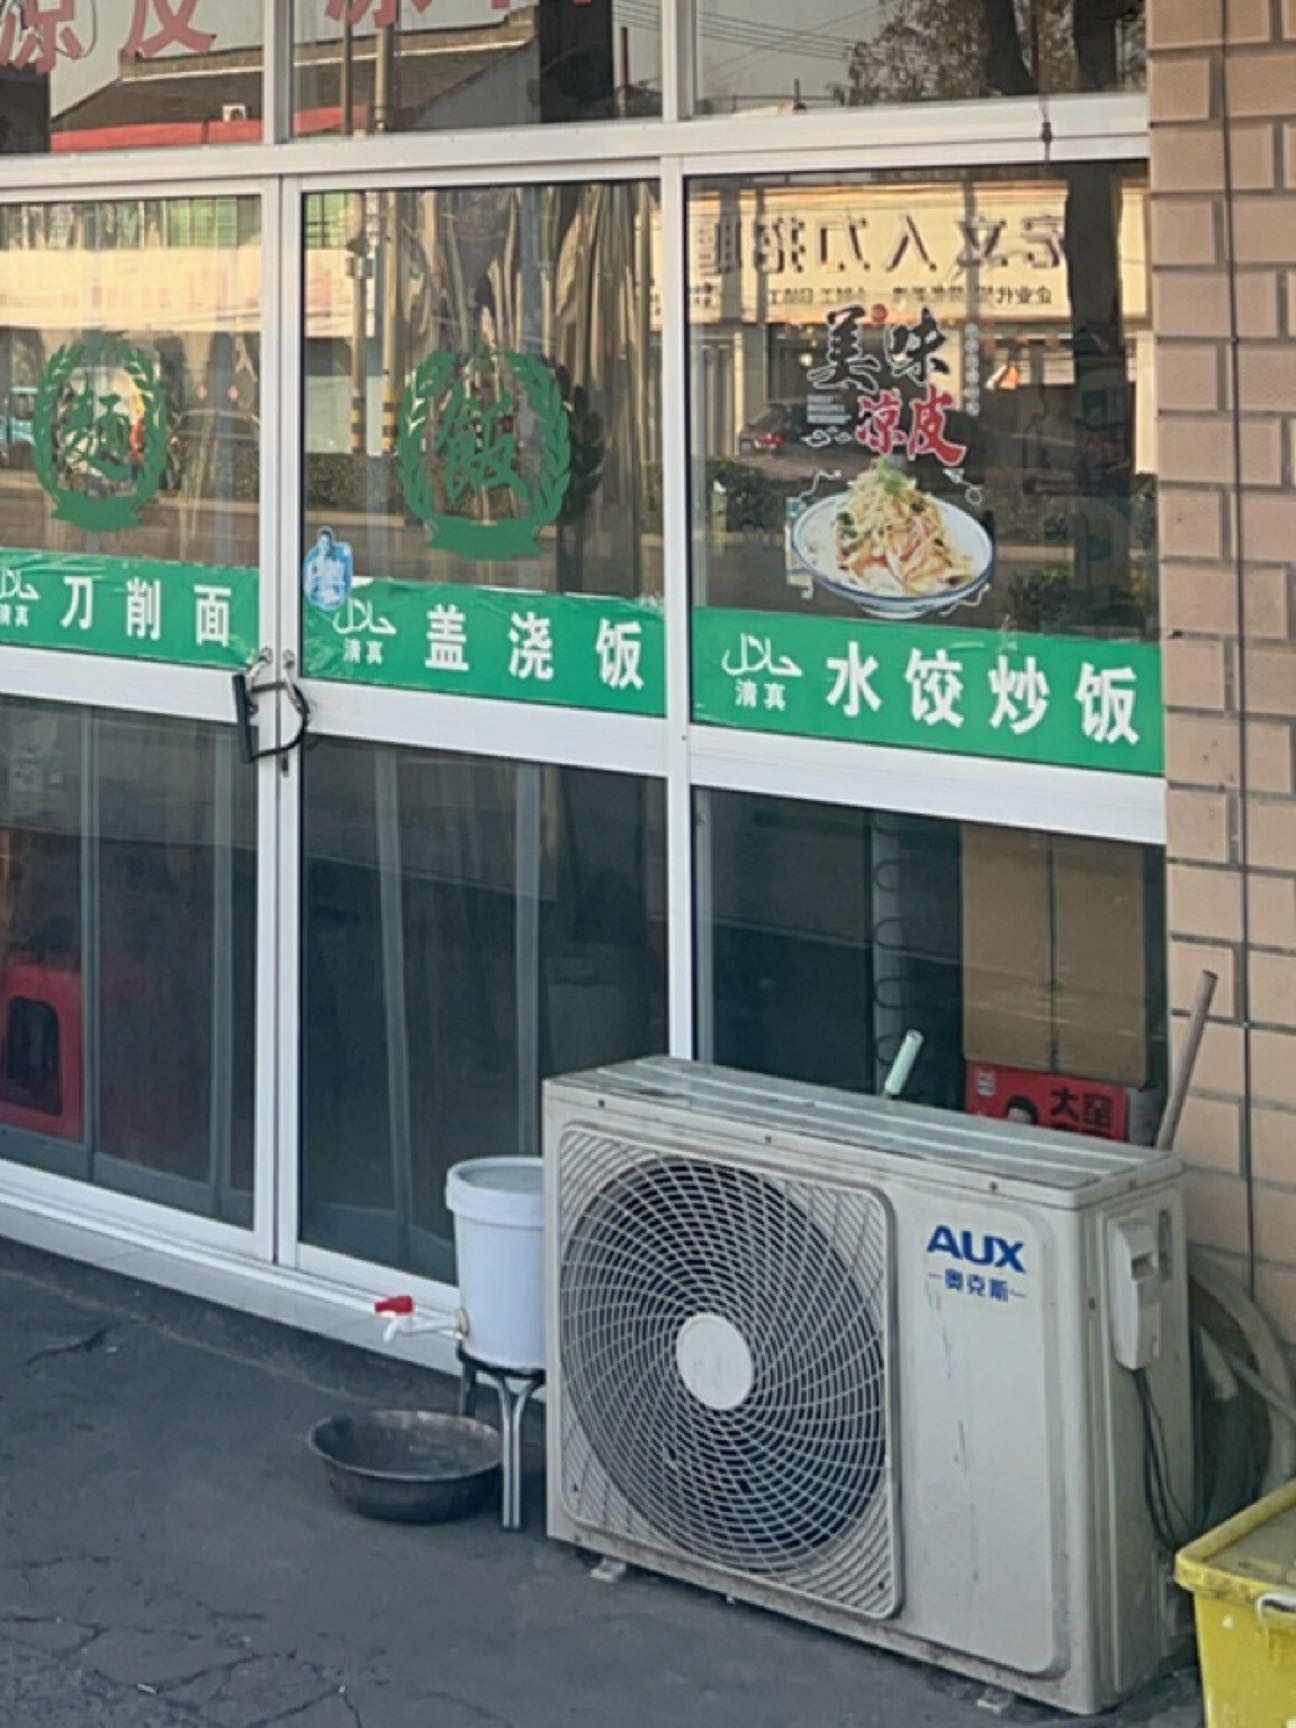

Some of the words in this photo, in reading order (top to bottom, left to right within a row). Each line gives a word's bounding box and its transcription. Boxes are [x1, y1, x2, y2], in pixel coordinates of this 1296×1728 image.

[806, 306, 952, 394] 美味
[856, 383, 968, 468] 凉皮
[60, 574, 233, 648] 刀削面
[424, 604, 645, 690] 盖浇饭
[825, 640, 1141, 747] 水饺炒饭
[926, 1224, 1026, 1274] AUX
[944, 1268, 1009, 1303] 奥克斯
